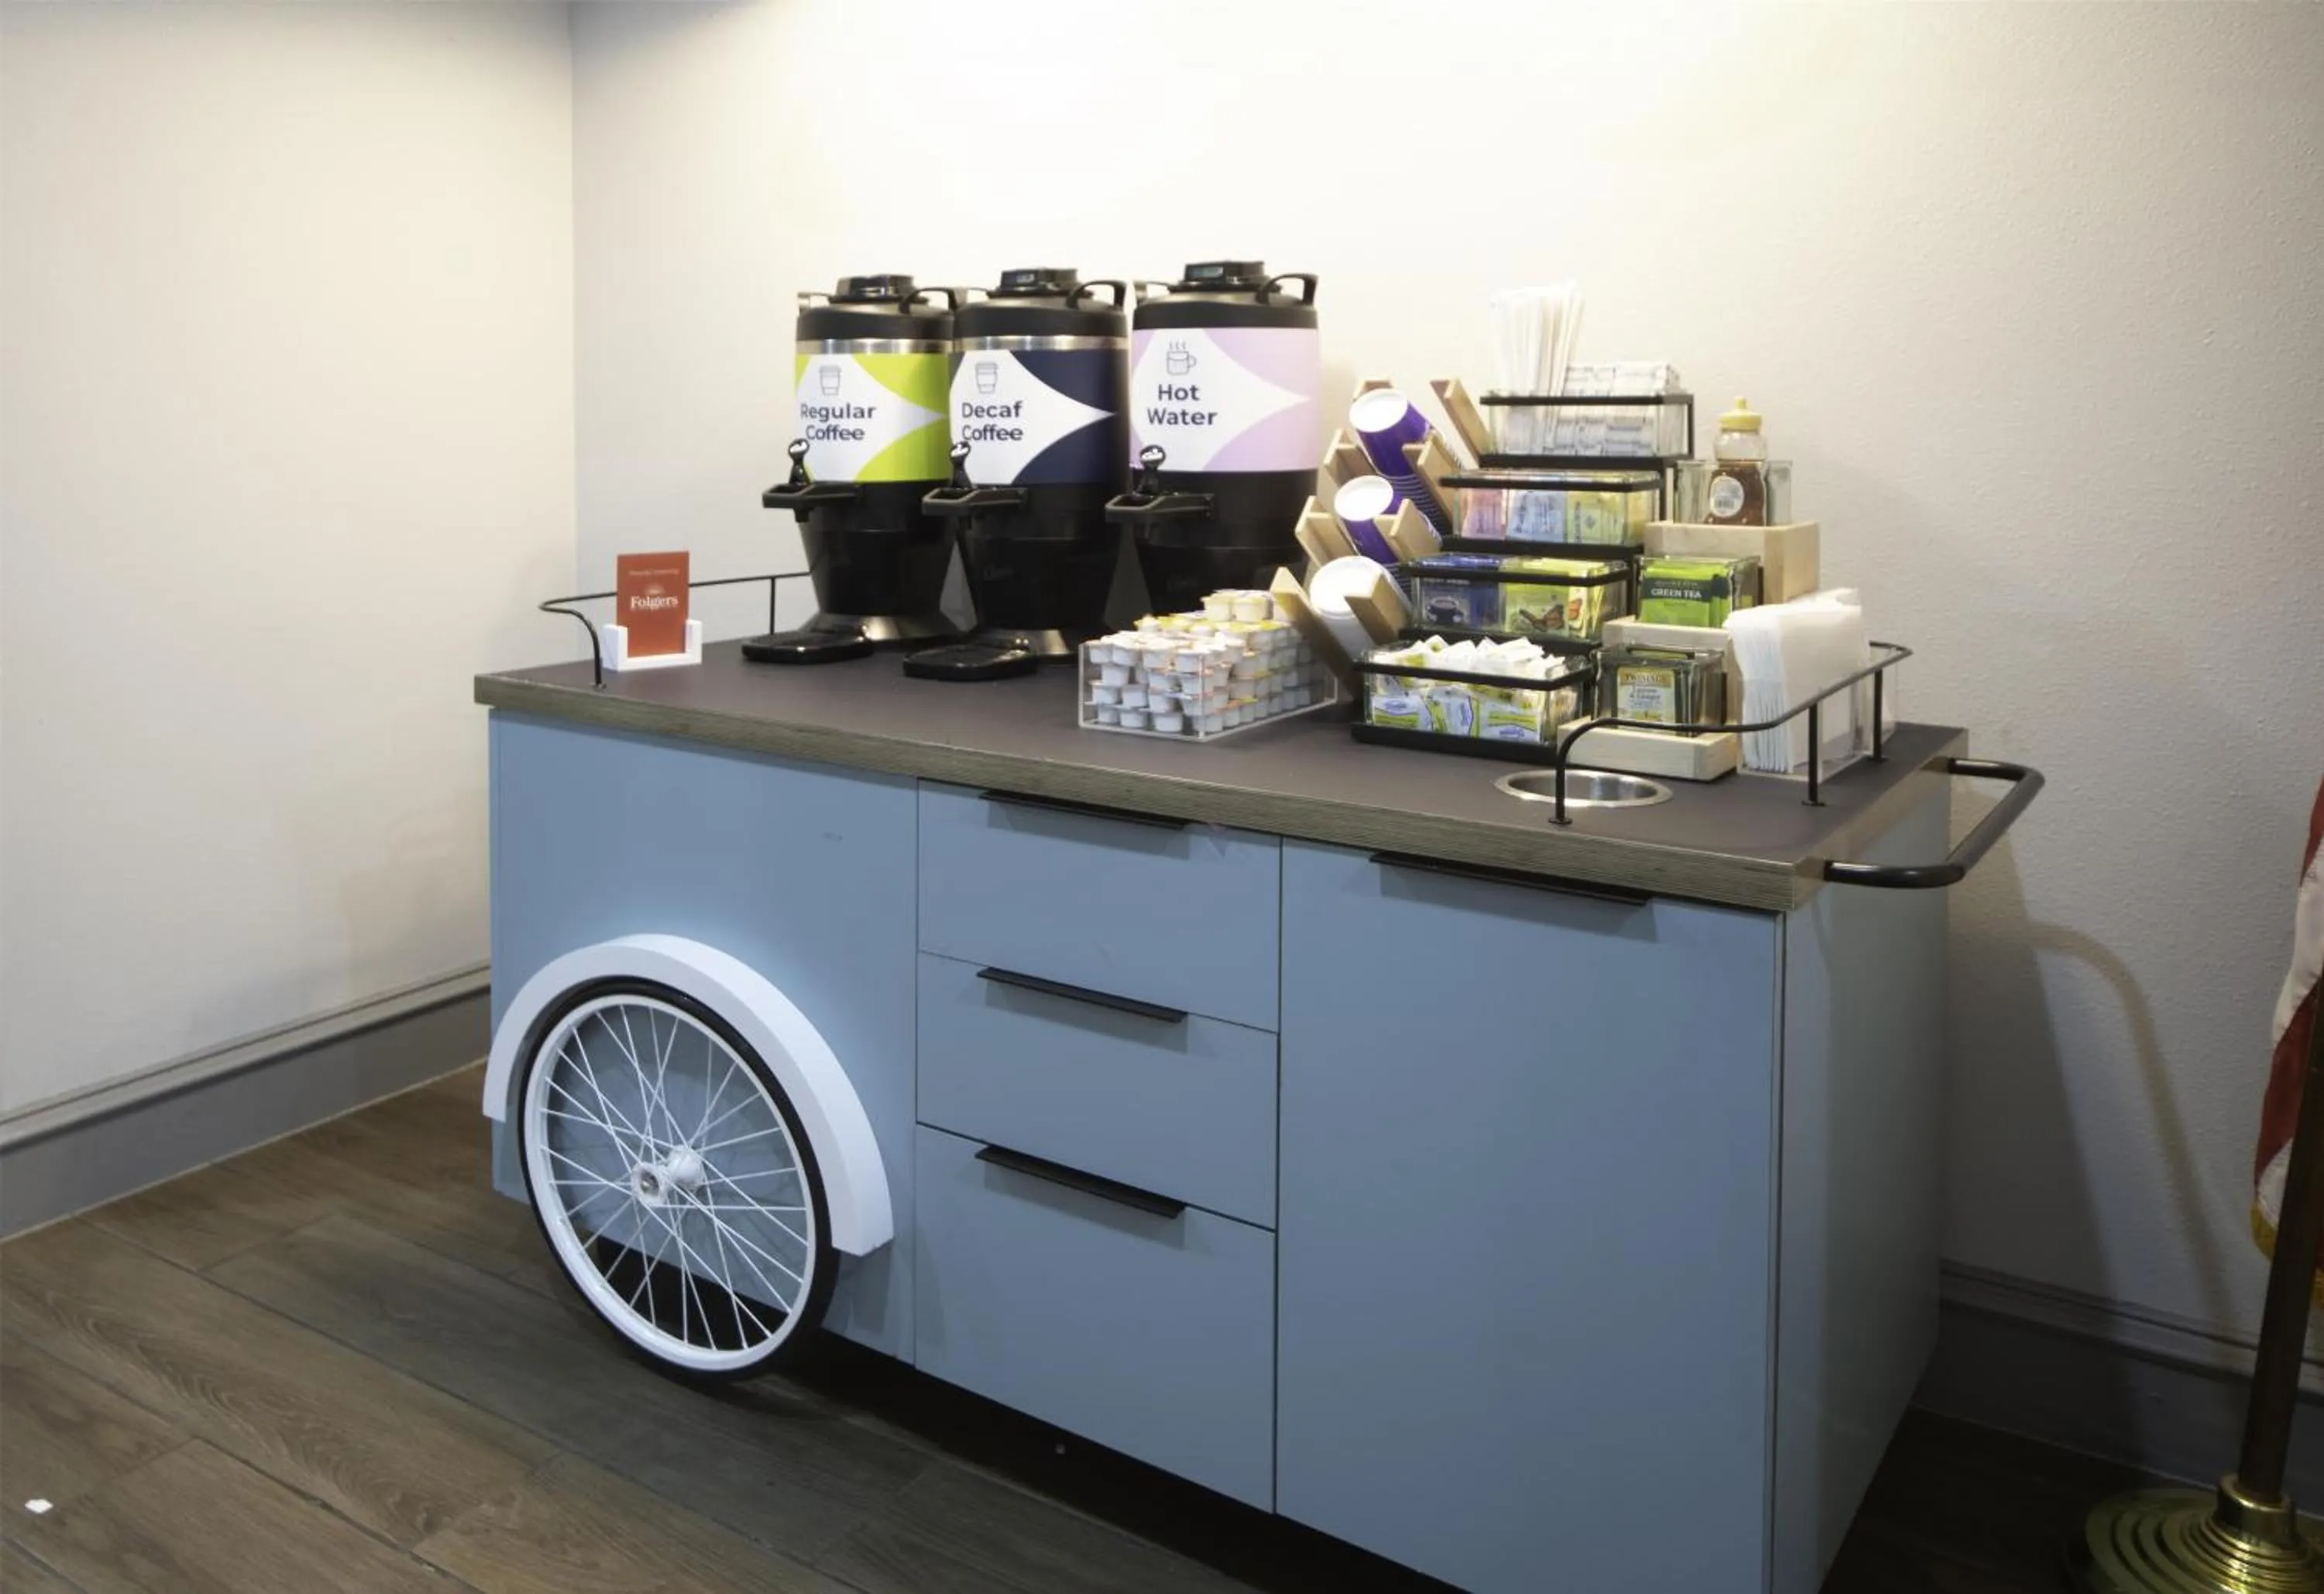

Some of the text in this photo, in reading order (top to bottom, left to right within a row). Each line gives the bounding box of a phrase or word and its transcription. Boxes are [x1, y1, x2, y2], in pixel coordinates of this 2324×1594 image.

[1157, 384, 1200, 401] Hot
[800, 403, 876, 423] Regular
[961, 400, 1023, 418] Decaf
[1147, 407, 1218, 425] Water
[806, 424, 865, 441] Coffee
[962, 424, 1023, 441] Coffee
[1650, 588, 1703, 599] GREEN TEA
[629, 595, 679, 613] Folgers
